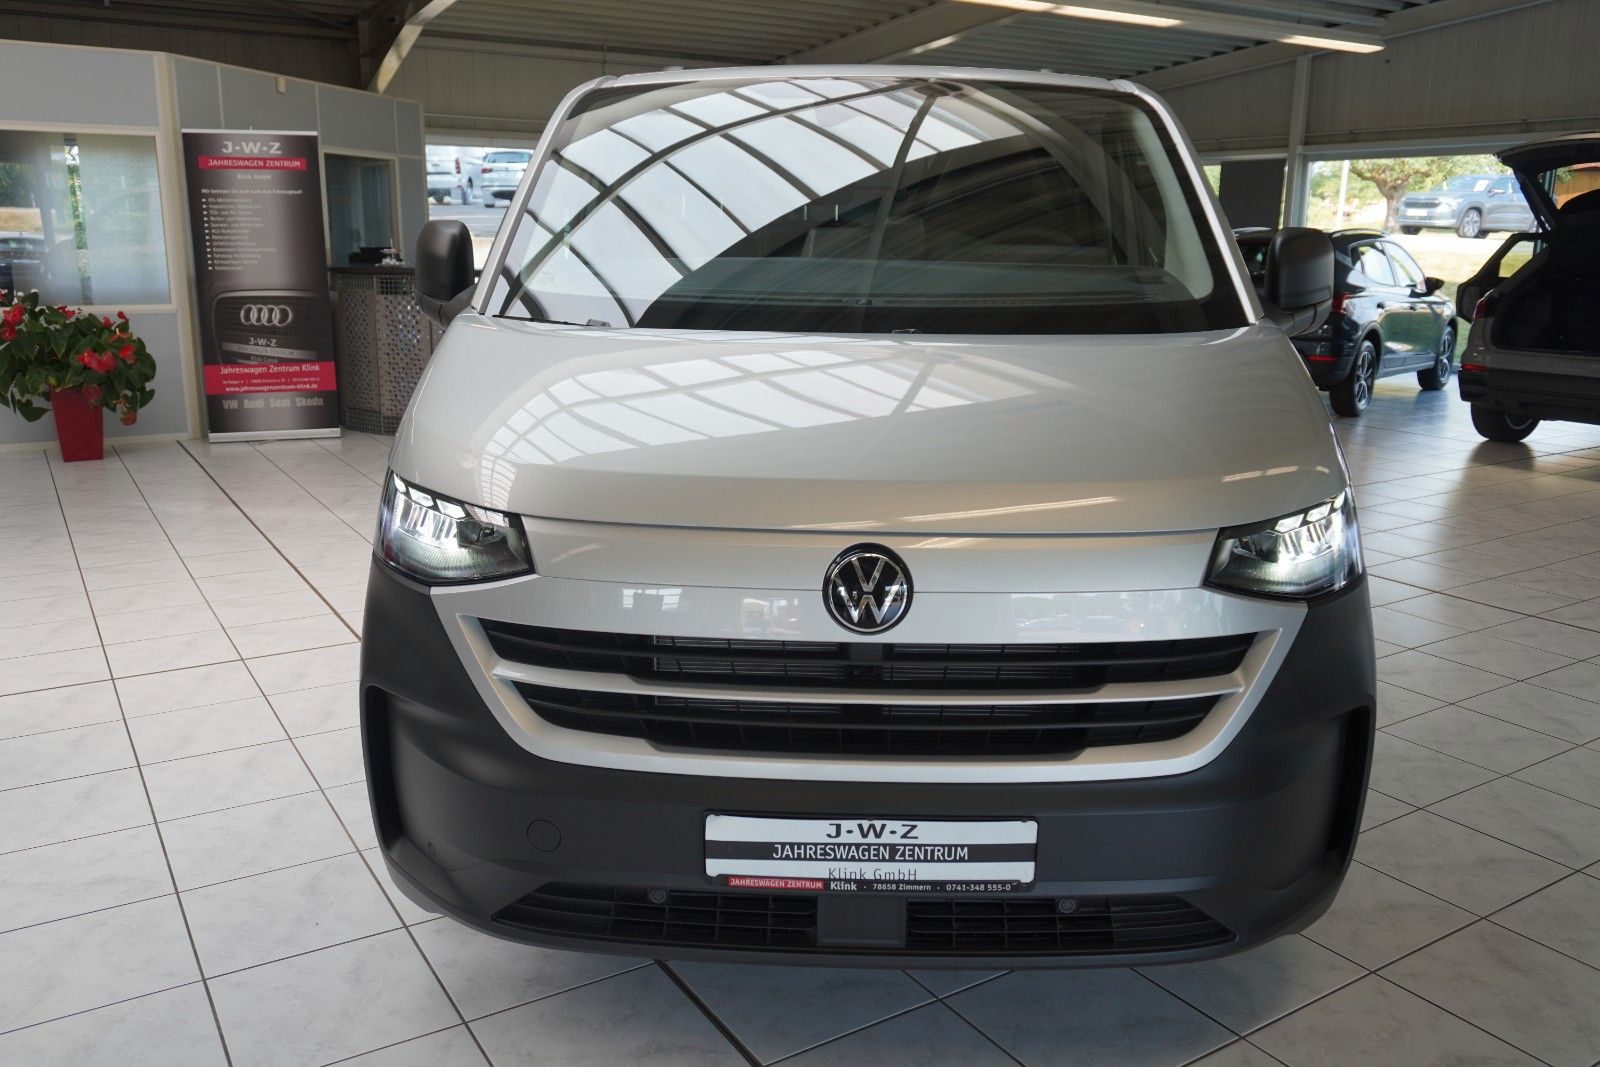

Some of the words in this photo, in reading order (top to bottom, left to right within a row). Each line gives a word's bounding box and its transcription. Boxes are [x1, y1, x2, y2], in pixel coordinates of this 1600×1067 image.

[208, 159, 265, 167] JAHRESWAGEN
[266, 160, 301, 168] ZENTRUM
[220, 366, 268, 375] Jahreswagen
[269, 364, 300, 373] Zentrum
[302, 364, 320, 372] Klink
[225, 384, 318, 392] www.jahreswagenzentrum-klink.de
[222, 399, 238, 409] VW
[244, 399, 264, 409] Audi
[270, 398, 291, 408] Seat
[295, 397, 324, 407] Skoda
[828, 553, 907, 628] VW
[773, 844, 890, 860] JAHRESWAGEN
[895, 846, 968, 861] ZENTRUM
[828, 867, 867, 880] Klink
[873, 868, 917, 881] GmbH
[730, 878, 785, 888] JAHRESWAGEN
[787, 879, 823, 889] ZENTRUM
[830, 881, 858, 891] Klink
[873, 883, 897, 891] 78658
[899, 883, 932, 891] Zimmern
[946, 883, 985, 891] 0741-348
[987, 883, 1011, 891] 555-0
